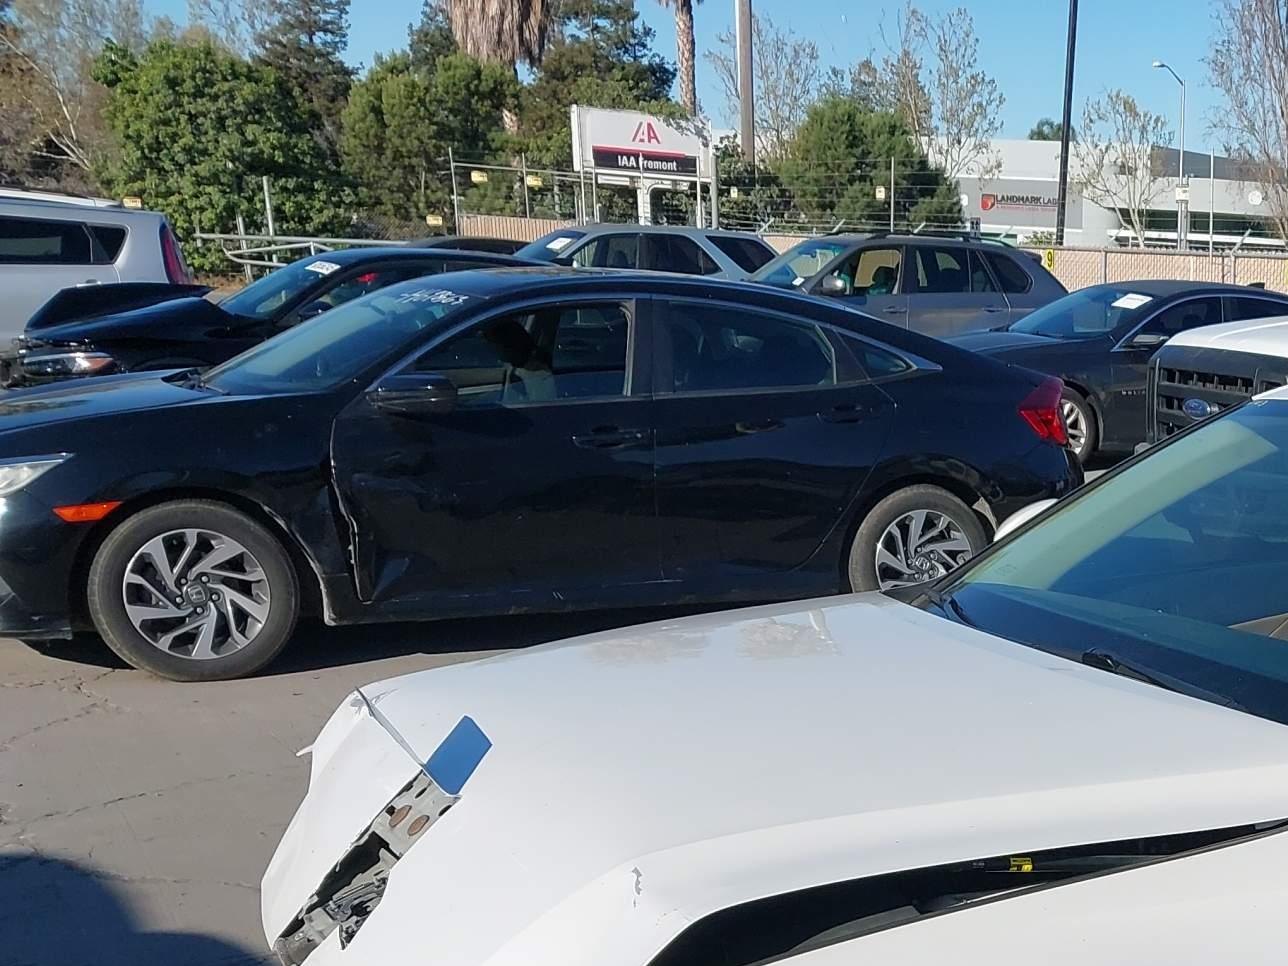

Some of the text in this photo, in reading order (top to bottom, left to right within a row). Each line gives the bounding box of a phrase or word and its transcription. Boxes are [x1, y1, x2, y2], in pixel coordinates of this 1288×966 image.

[618, 155, 637, 168] IAA
[996, 194, 1042, 204] LANDMARK
[1046, 250, 1053, 268] 9
